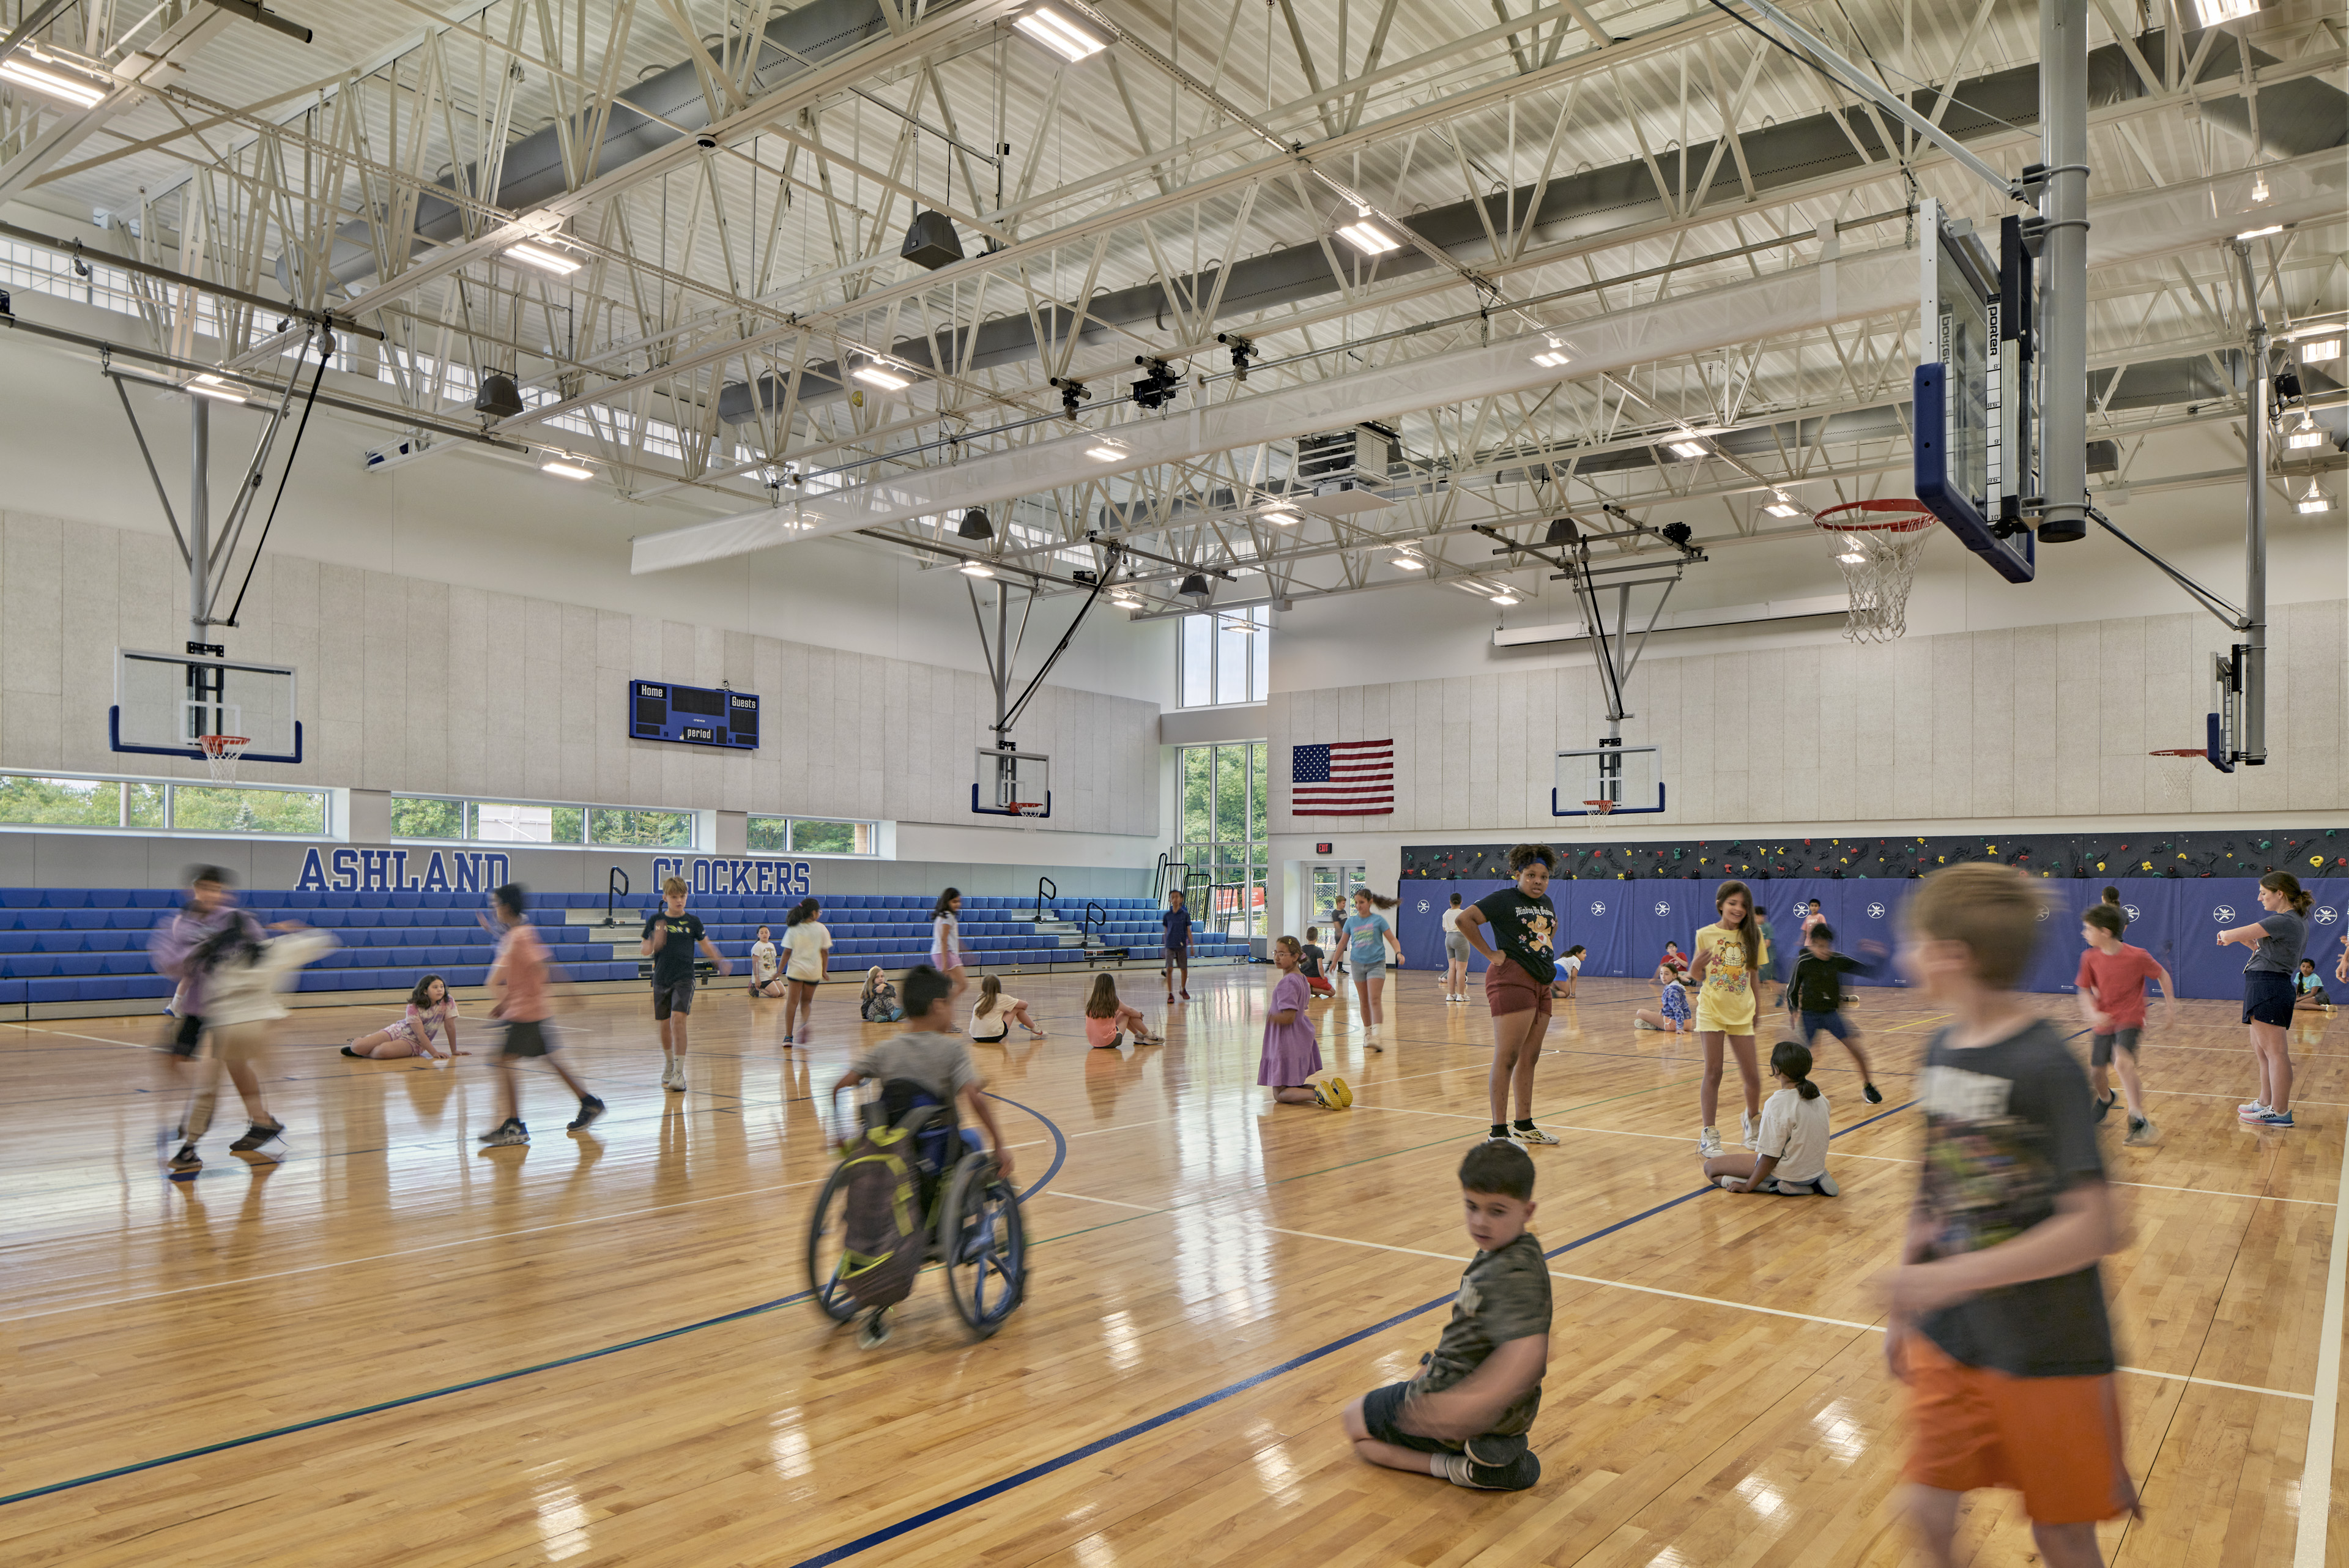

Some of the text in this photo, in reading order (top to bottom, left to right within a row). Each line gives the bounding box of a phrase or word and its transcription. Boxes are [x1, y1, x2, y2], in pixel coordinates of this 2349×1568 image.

[642, 685, 662, 697] Home
[732, 696, 756, 708] Guests
[687, 729, 711, 739] period
[1318, 844, 1329, 852] EXIT
[294, 846, 811, 896] ASHLAND CLOCKERS
